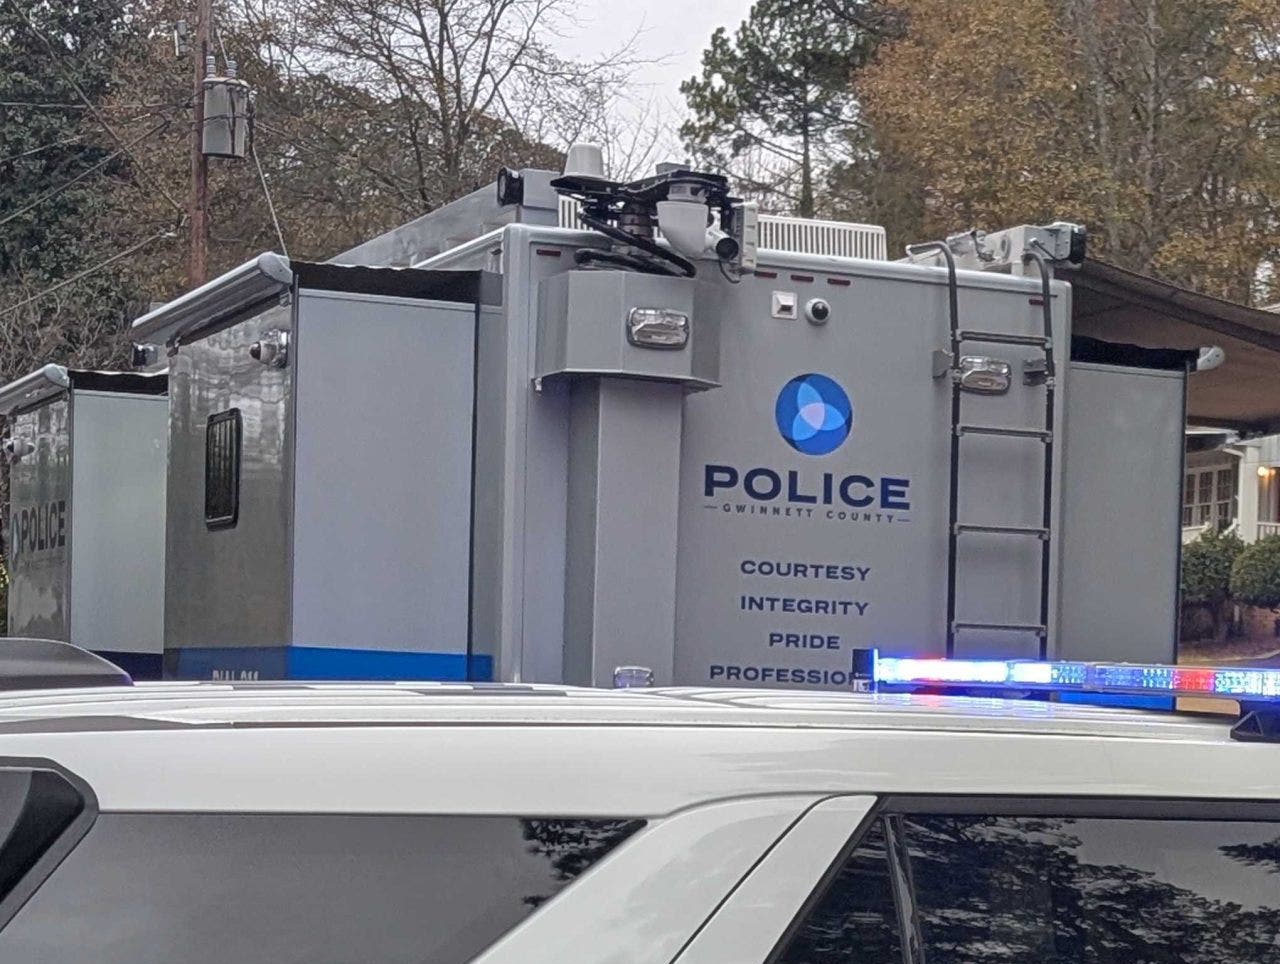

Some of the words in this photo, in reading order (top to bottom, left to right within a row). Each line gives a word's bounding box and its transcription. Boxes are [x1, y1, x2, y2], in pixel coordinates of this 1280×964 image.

[704, 464, 910, 510] POLICE
[723, 503, 813, 518] GWINNETT
[826, 510, 893, 523] COUNTY
[22, 501, 66, 553] POLICE
[740, 560, 871, 581] COURTESY
[740, 596, 869, 616] INTEGRITY
[769, 633, 841, 649] PRIDE
